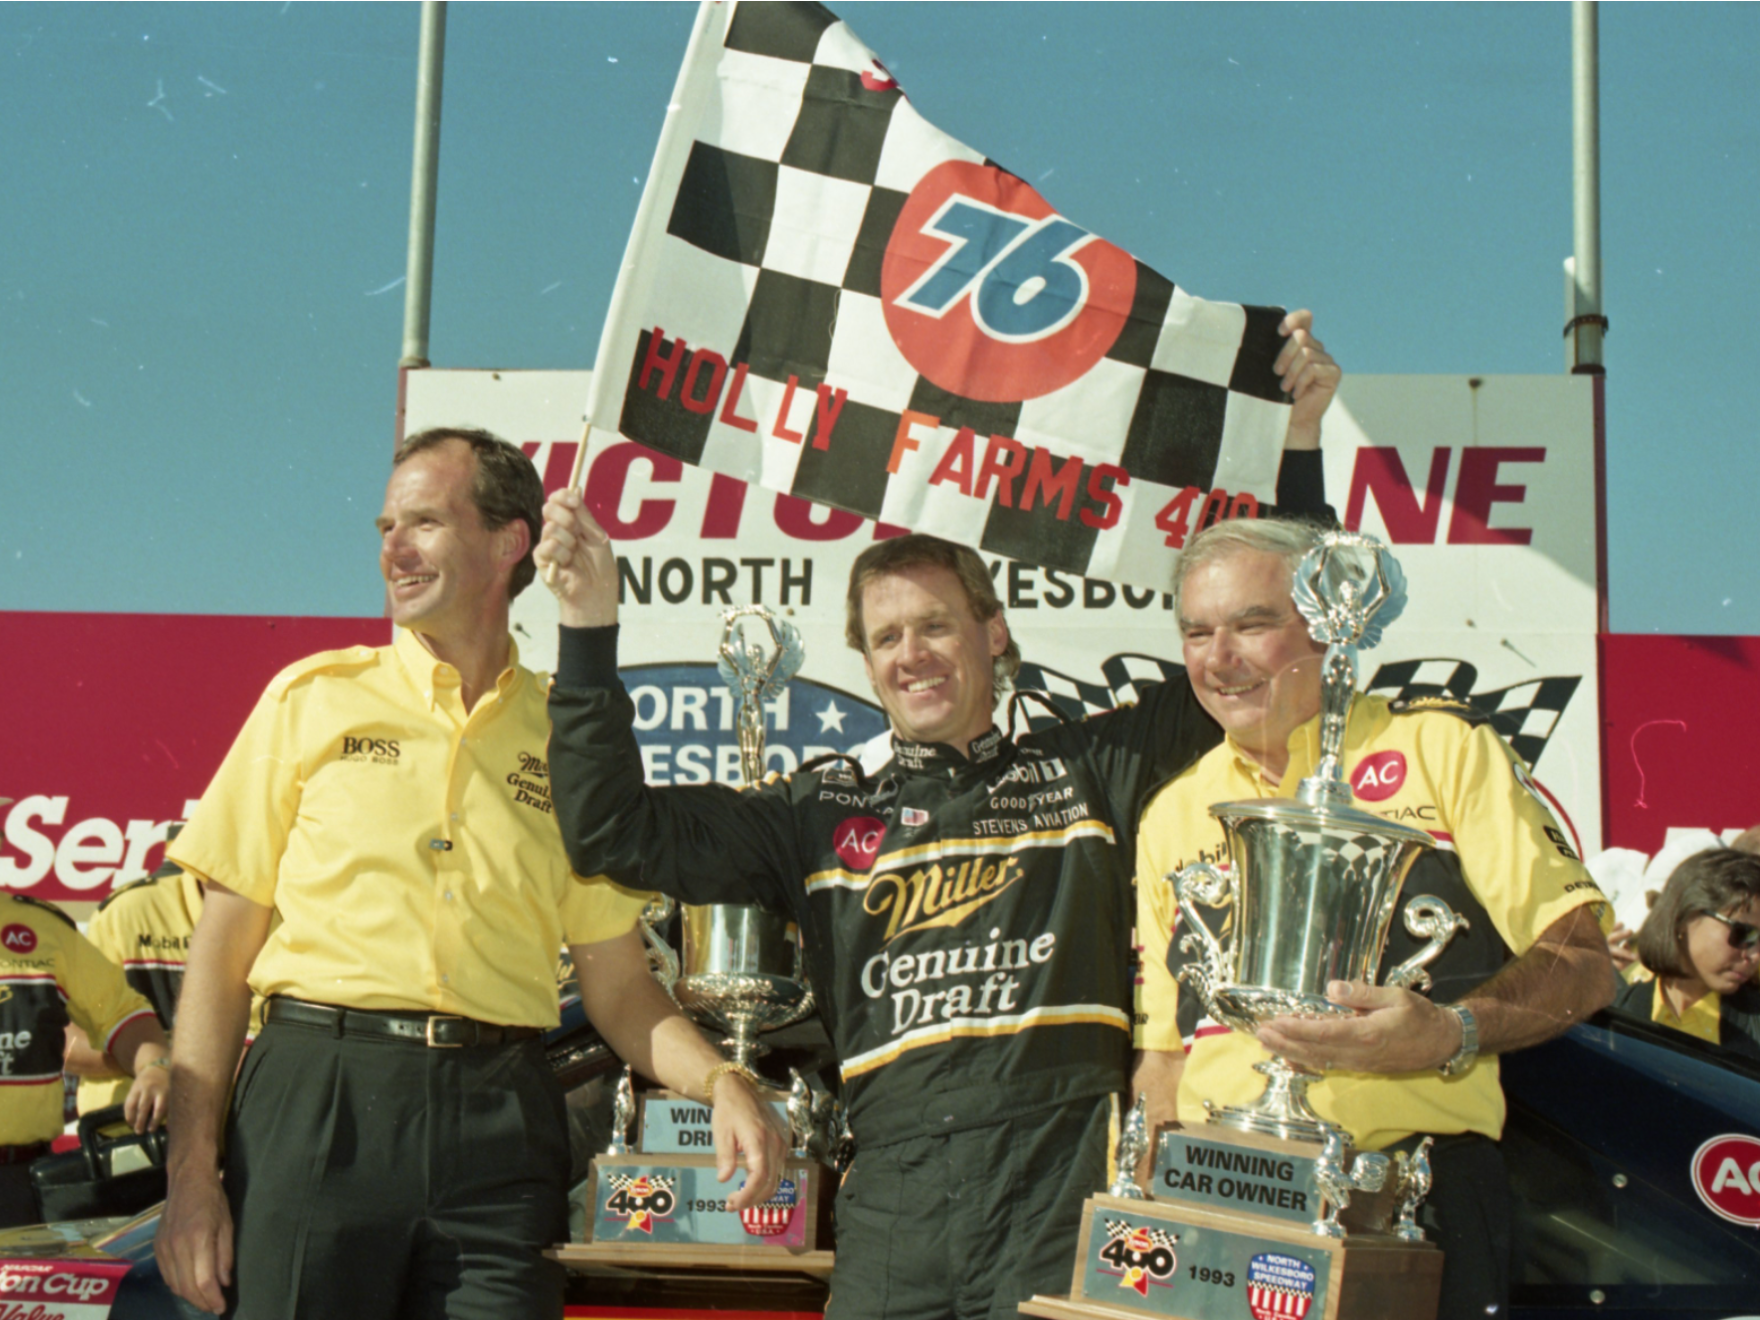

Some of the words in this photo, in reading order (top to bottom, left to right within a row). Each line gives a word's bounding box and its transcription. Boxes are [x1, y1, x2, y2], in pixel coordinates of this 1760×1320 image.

[892, 192, 1101, 344] 76
[639, 326, 848, 451] HOLLY
[886, 409, 1130, 530] FARMS
[616, 556, 812, 606] NORTH
[628, 685, 790, 731] ORTH
[343, 736, 400, 758] BOSS
[1356, 760, 1399, 790] AC
[973, 818, 1028, 835] STEVENS
[1034, 802, 1089, 829] AVIATION
[0, 795, 200, 890] Ser
[841, 828, 879, 854] AC
[863, 857, 1024, 941] Miller
[5, 930, 32, 946] AC
[861, 927, 1055, 998] Genuine
[891, 971, 1020, 1035] Draft
[1185, 1144, 1295, 1182] WINNING
[686, 1199, 727, 1213] 1993
[1164, 1168, 1213, 1194] CAR
[1217, 1178, 1308, 1212] OWNER
[1188, 1264, 1236, 1288] 1993
[1251, 1261, 1315, 1282] WILKESBORO
[1266, 1253, 1301, 1270] NORTH
[43, 1272, 109, 1301] Cup
[1253, 1271, 1308, 1290] SPEEDWAY
